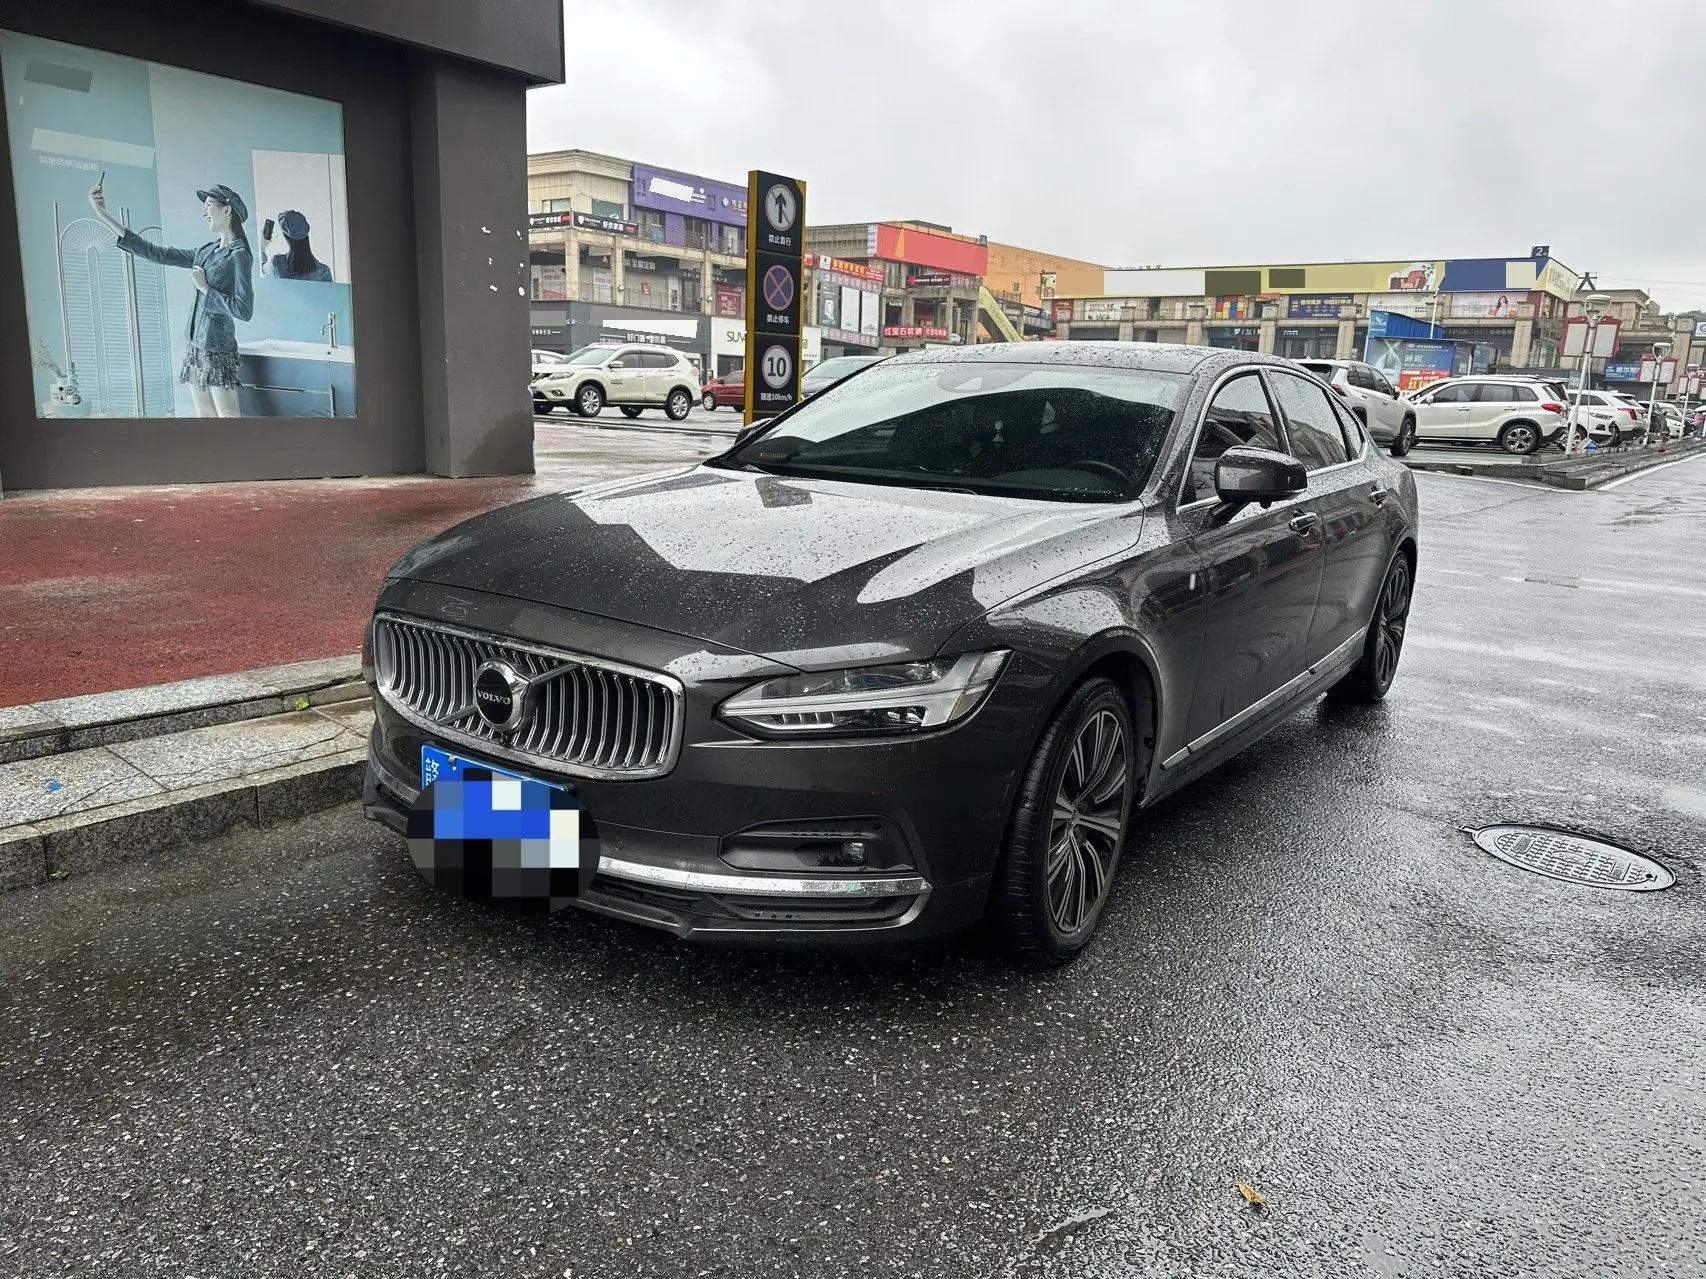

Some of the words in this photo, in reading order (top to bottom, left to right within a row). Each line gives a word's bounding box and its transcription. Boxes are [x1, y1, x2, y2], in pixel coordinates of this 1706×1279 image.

[766, 314, 790, 324] 禁止停车
[767, 356, 787, 378] 10
[476, 689, 511, 705] VOLVO
